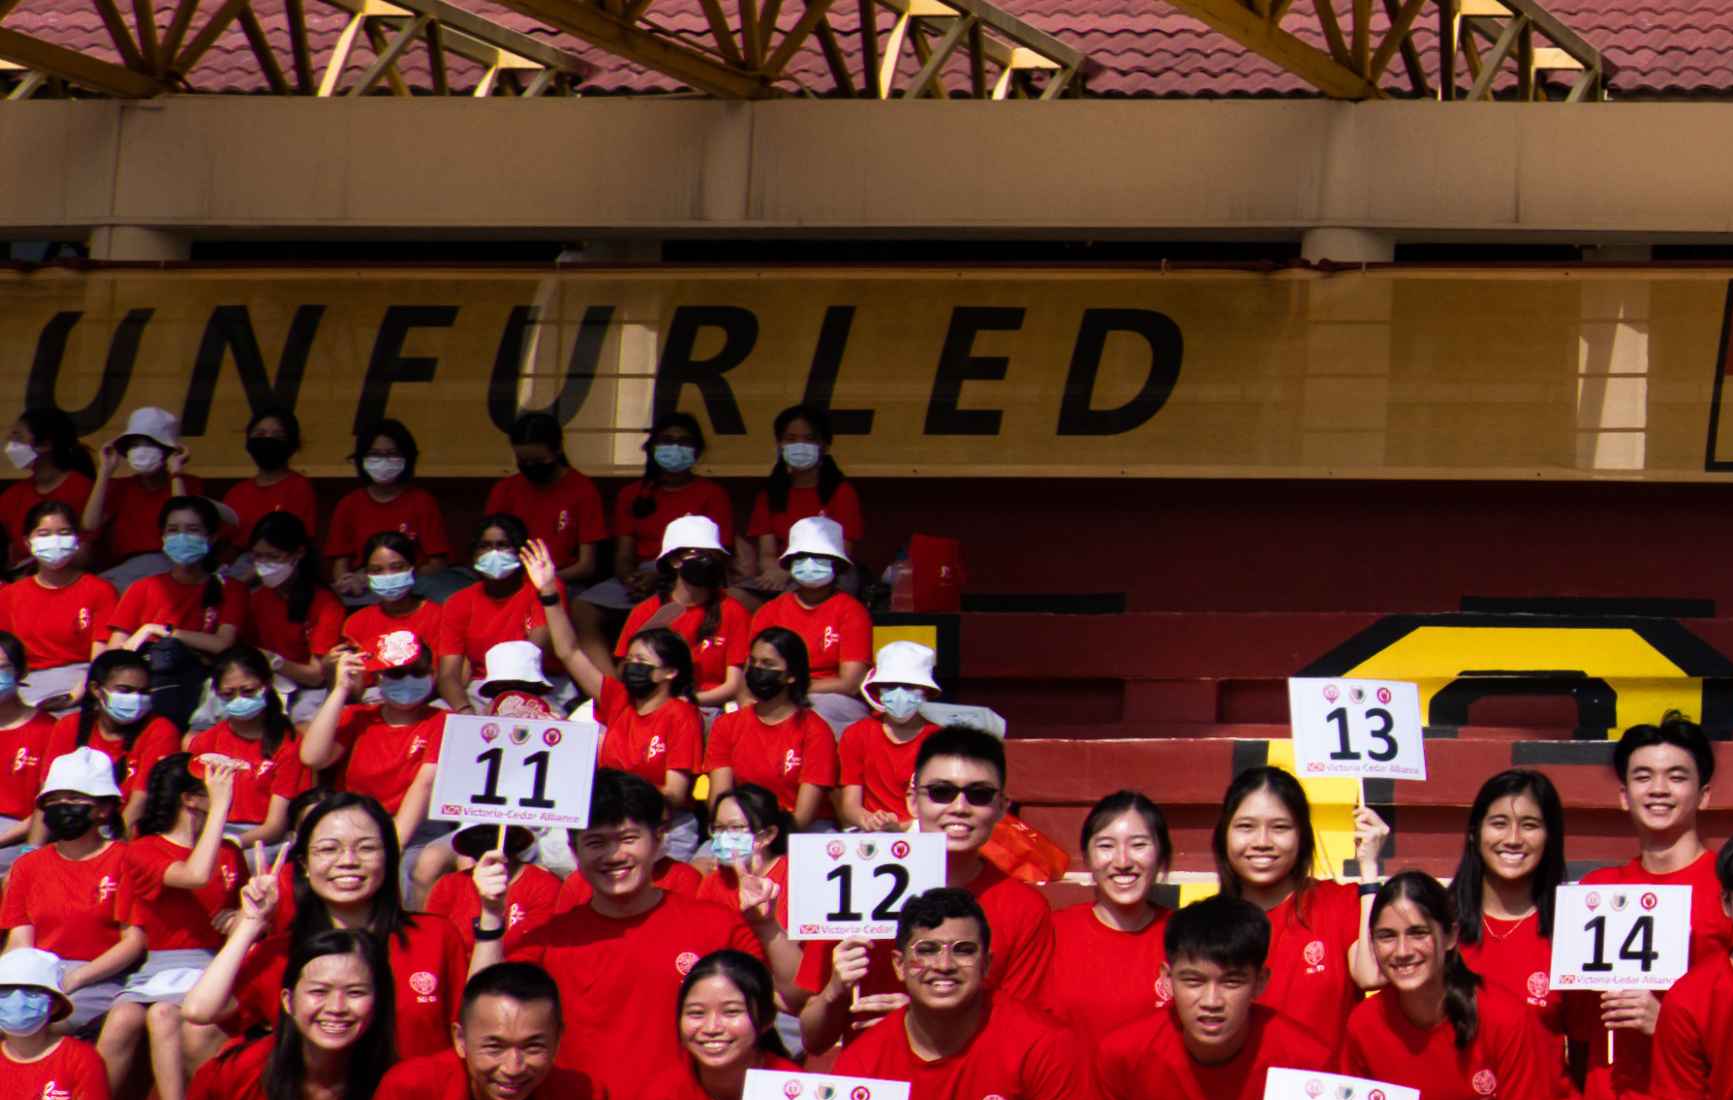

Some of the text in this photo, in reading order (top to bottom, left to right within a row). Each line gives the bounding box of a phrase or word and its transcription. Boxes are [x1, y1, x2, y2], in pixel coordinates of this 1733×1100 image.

[25, 303, 1185, 438] UNFURLED
[1326, 707, 1398, 762] 13
[470, 747, 556, 809] 11
[826, 863, 910, 922] 12
[1582, 916, 1659, 972] 14
